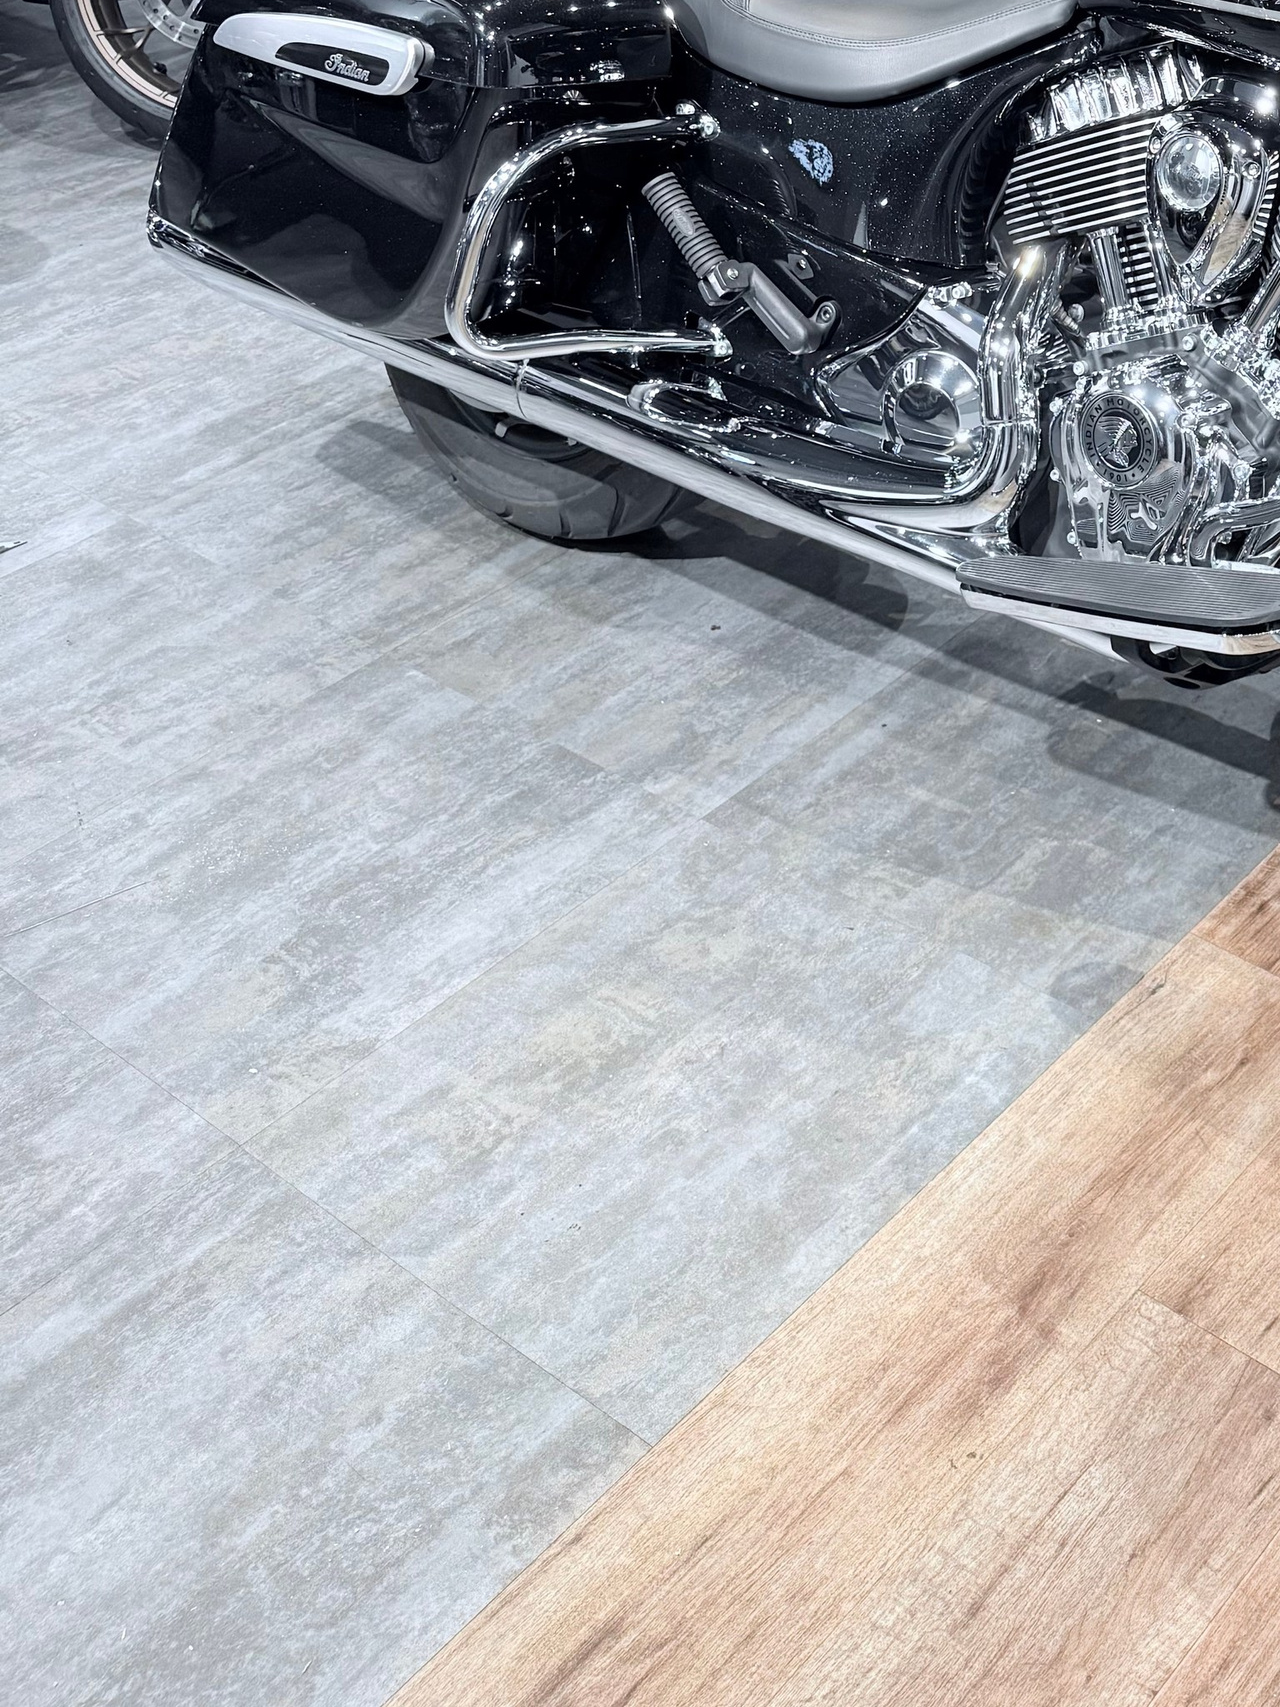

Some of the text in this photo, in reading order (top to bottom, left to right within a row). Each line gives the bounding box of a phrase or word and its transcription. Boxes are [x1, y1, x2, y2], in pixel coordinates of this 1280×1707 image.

[324, 53, 371, 82] Indian
[1085, 398, 1153, 473] INDIAN MOTORCYCLE
